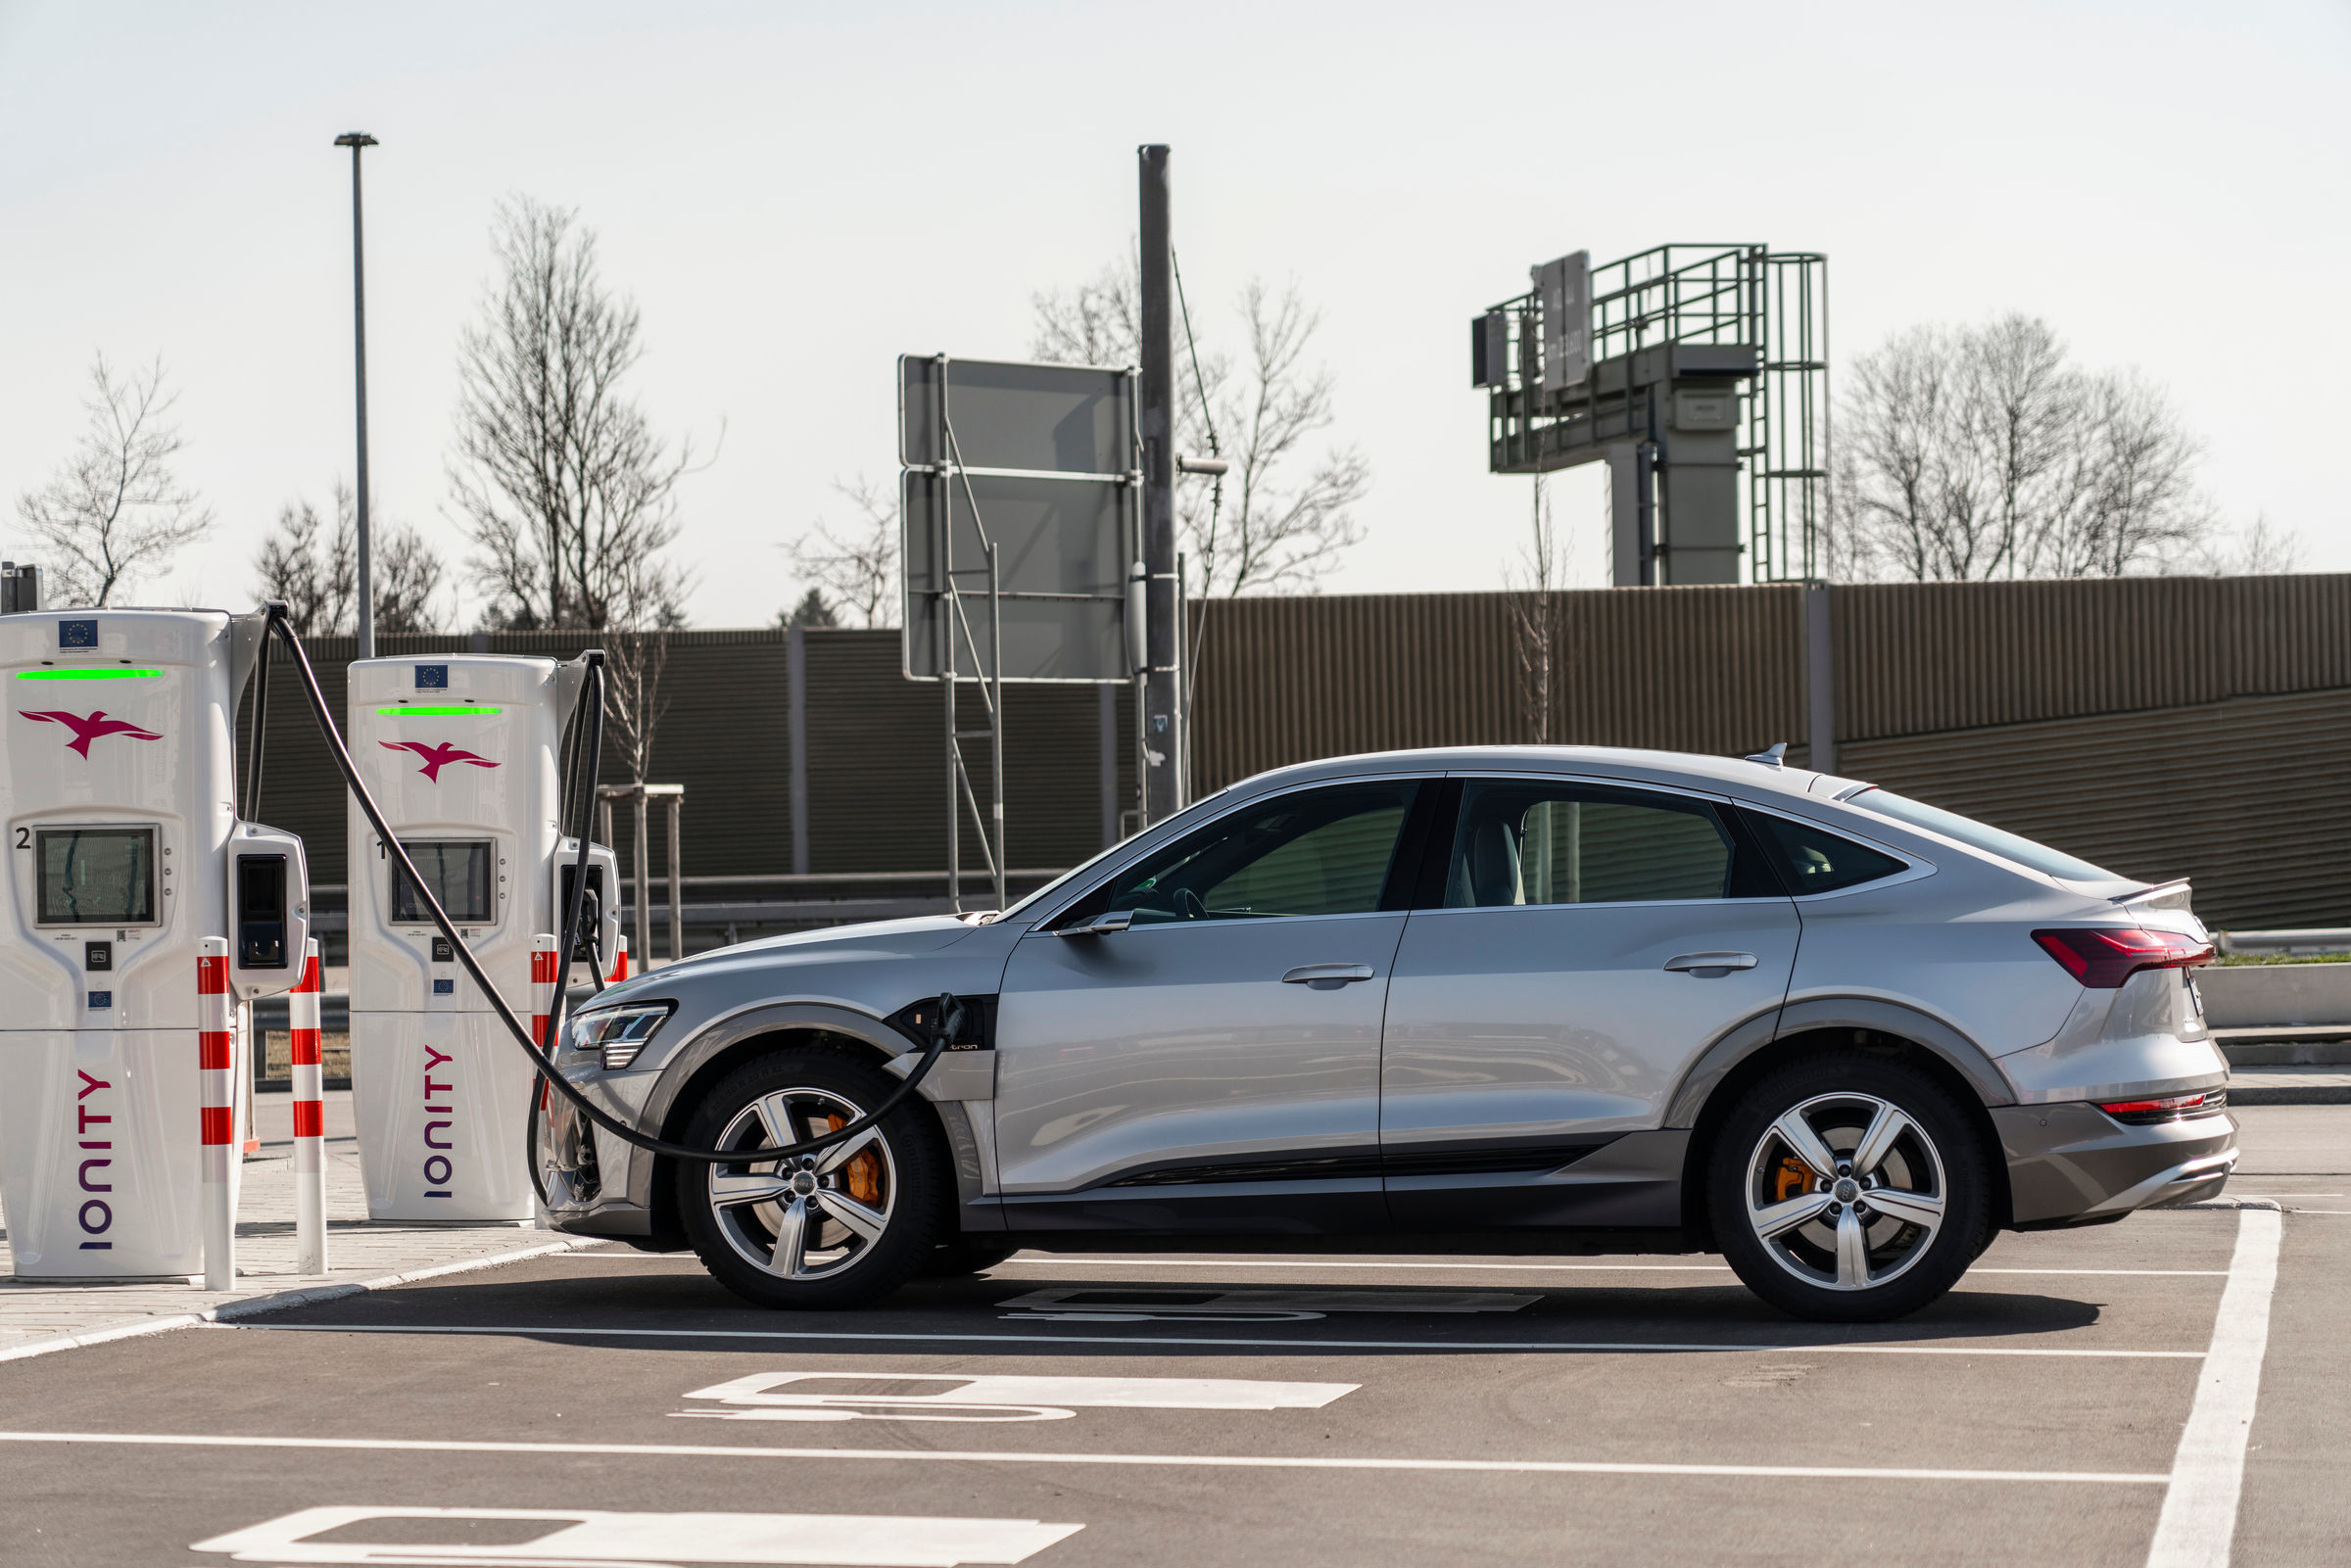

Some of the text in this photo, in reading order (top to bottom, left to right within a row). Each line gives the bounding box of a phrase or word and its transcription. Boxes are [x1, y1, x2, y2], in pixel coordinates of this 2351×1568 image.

[16, 827, 31, 849] 2
[376, 840, 386, 860] 1
[77, 1069, 113, 1250] IONITY
[424, 1044, 454, 1198] IONITY
